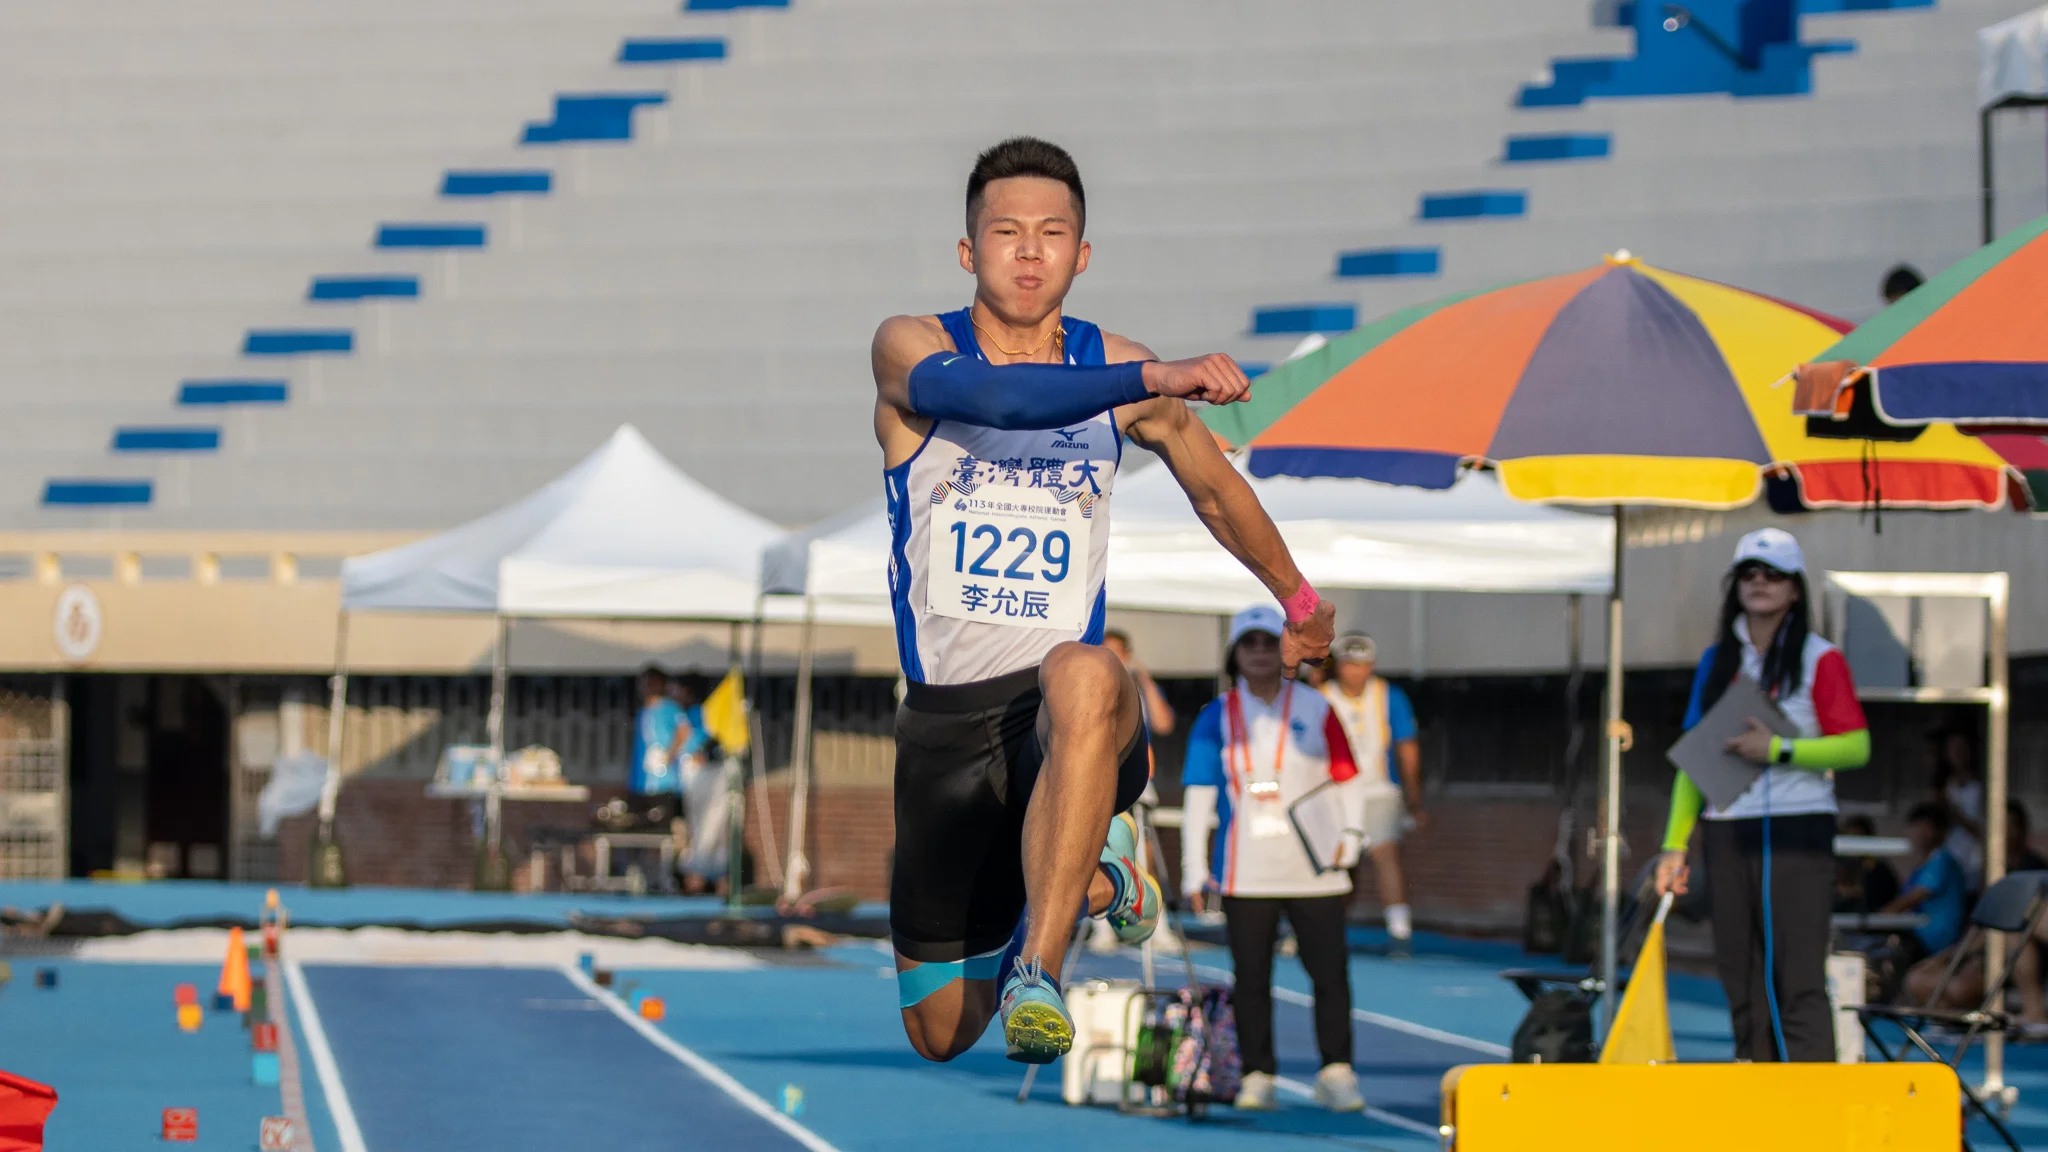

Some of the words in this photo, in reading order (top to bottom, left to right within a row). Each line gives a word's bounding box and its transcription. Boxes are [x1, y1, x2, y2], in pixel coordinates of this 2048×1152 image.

[952, 455, 1101, 495] 臺灣體大
[950, 521, 1071, 583] 1229
[961, 584, 1050, 620] 李允辰
